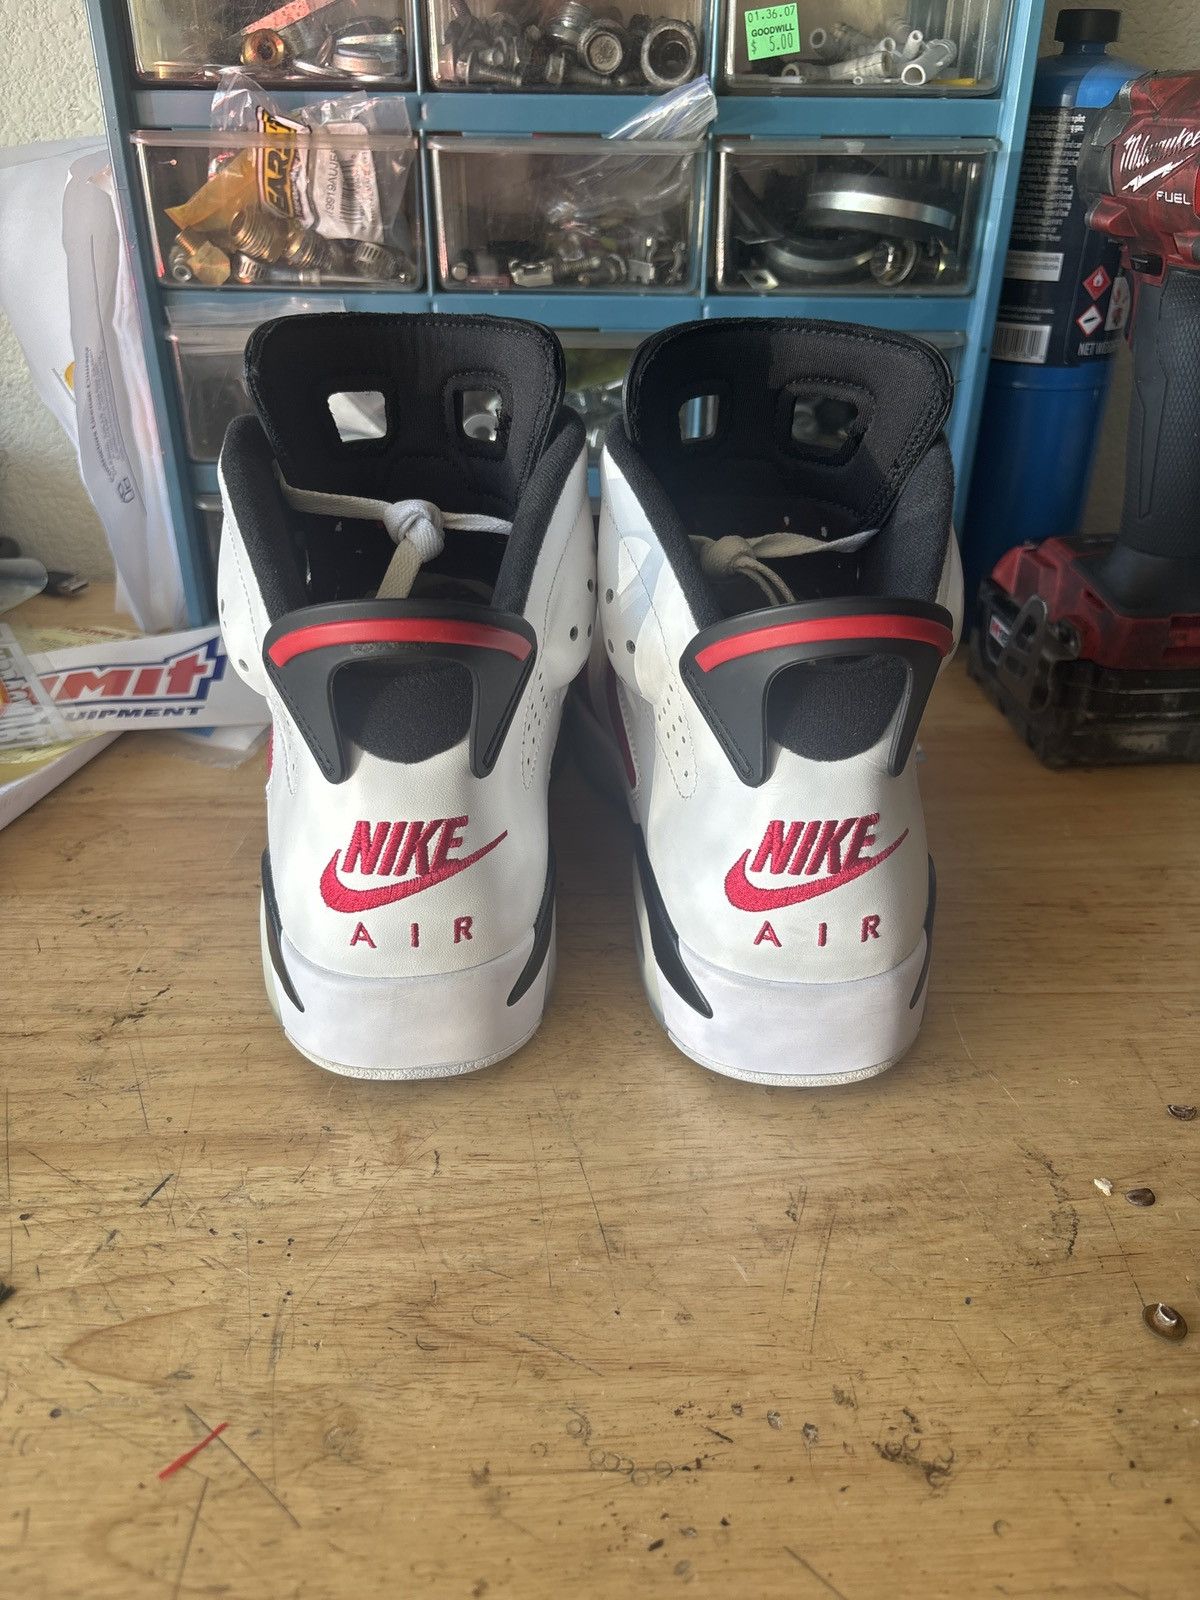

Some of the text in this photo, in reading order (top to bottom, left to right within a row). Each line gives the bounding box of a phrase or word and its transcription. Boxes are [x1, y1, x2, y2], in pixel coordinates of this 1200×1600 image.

[747, 5, 796, 23] 01.36.07
[751, 23, 795, 37] GOODWILL
[751, 32, 793, 54] $ 5.00
[1156, 190, 1191, 206] FUEL
[65, 705, 204, 722] UIPMENT
[341, 814, 469, 876] NIKE
[752, 812, 881, 875] NIKE
[350, 916, 474, 949] AIR
[754, 914, 882, 948] AIR
